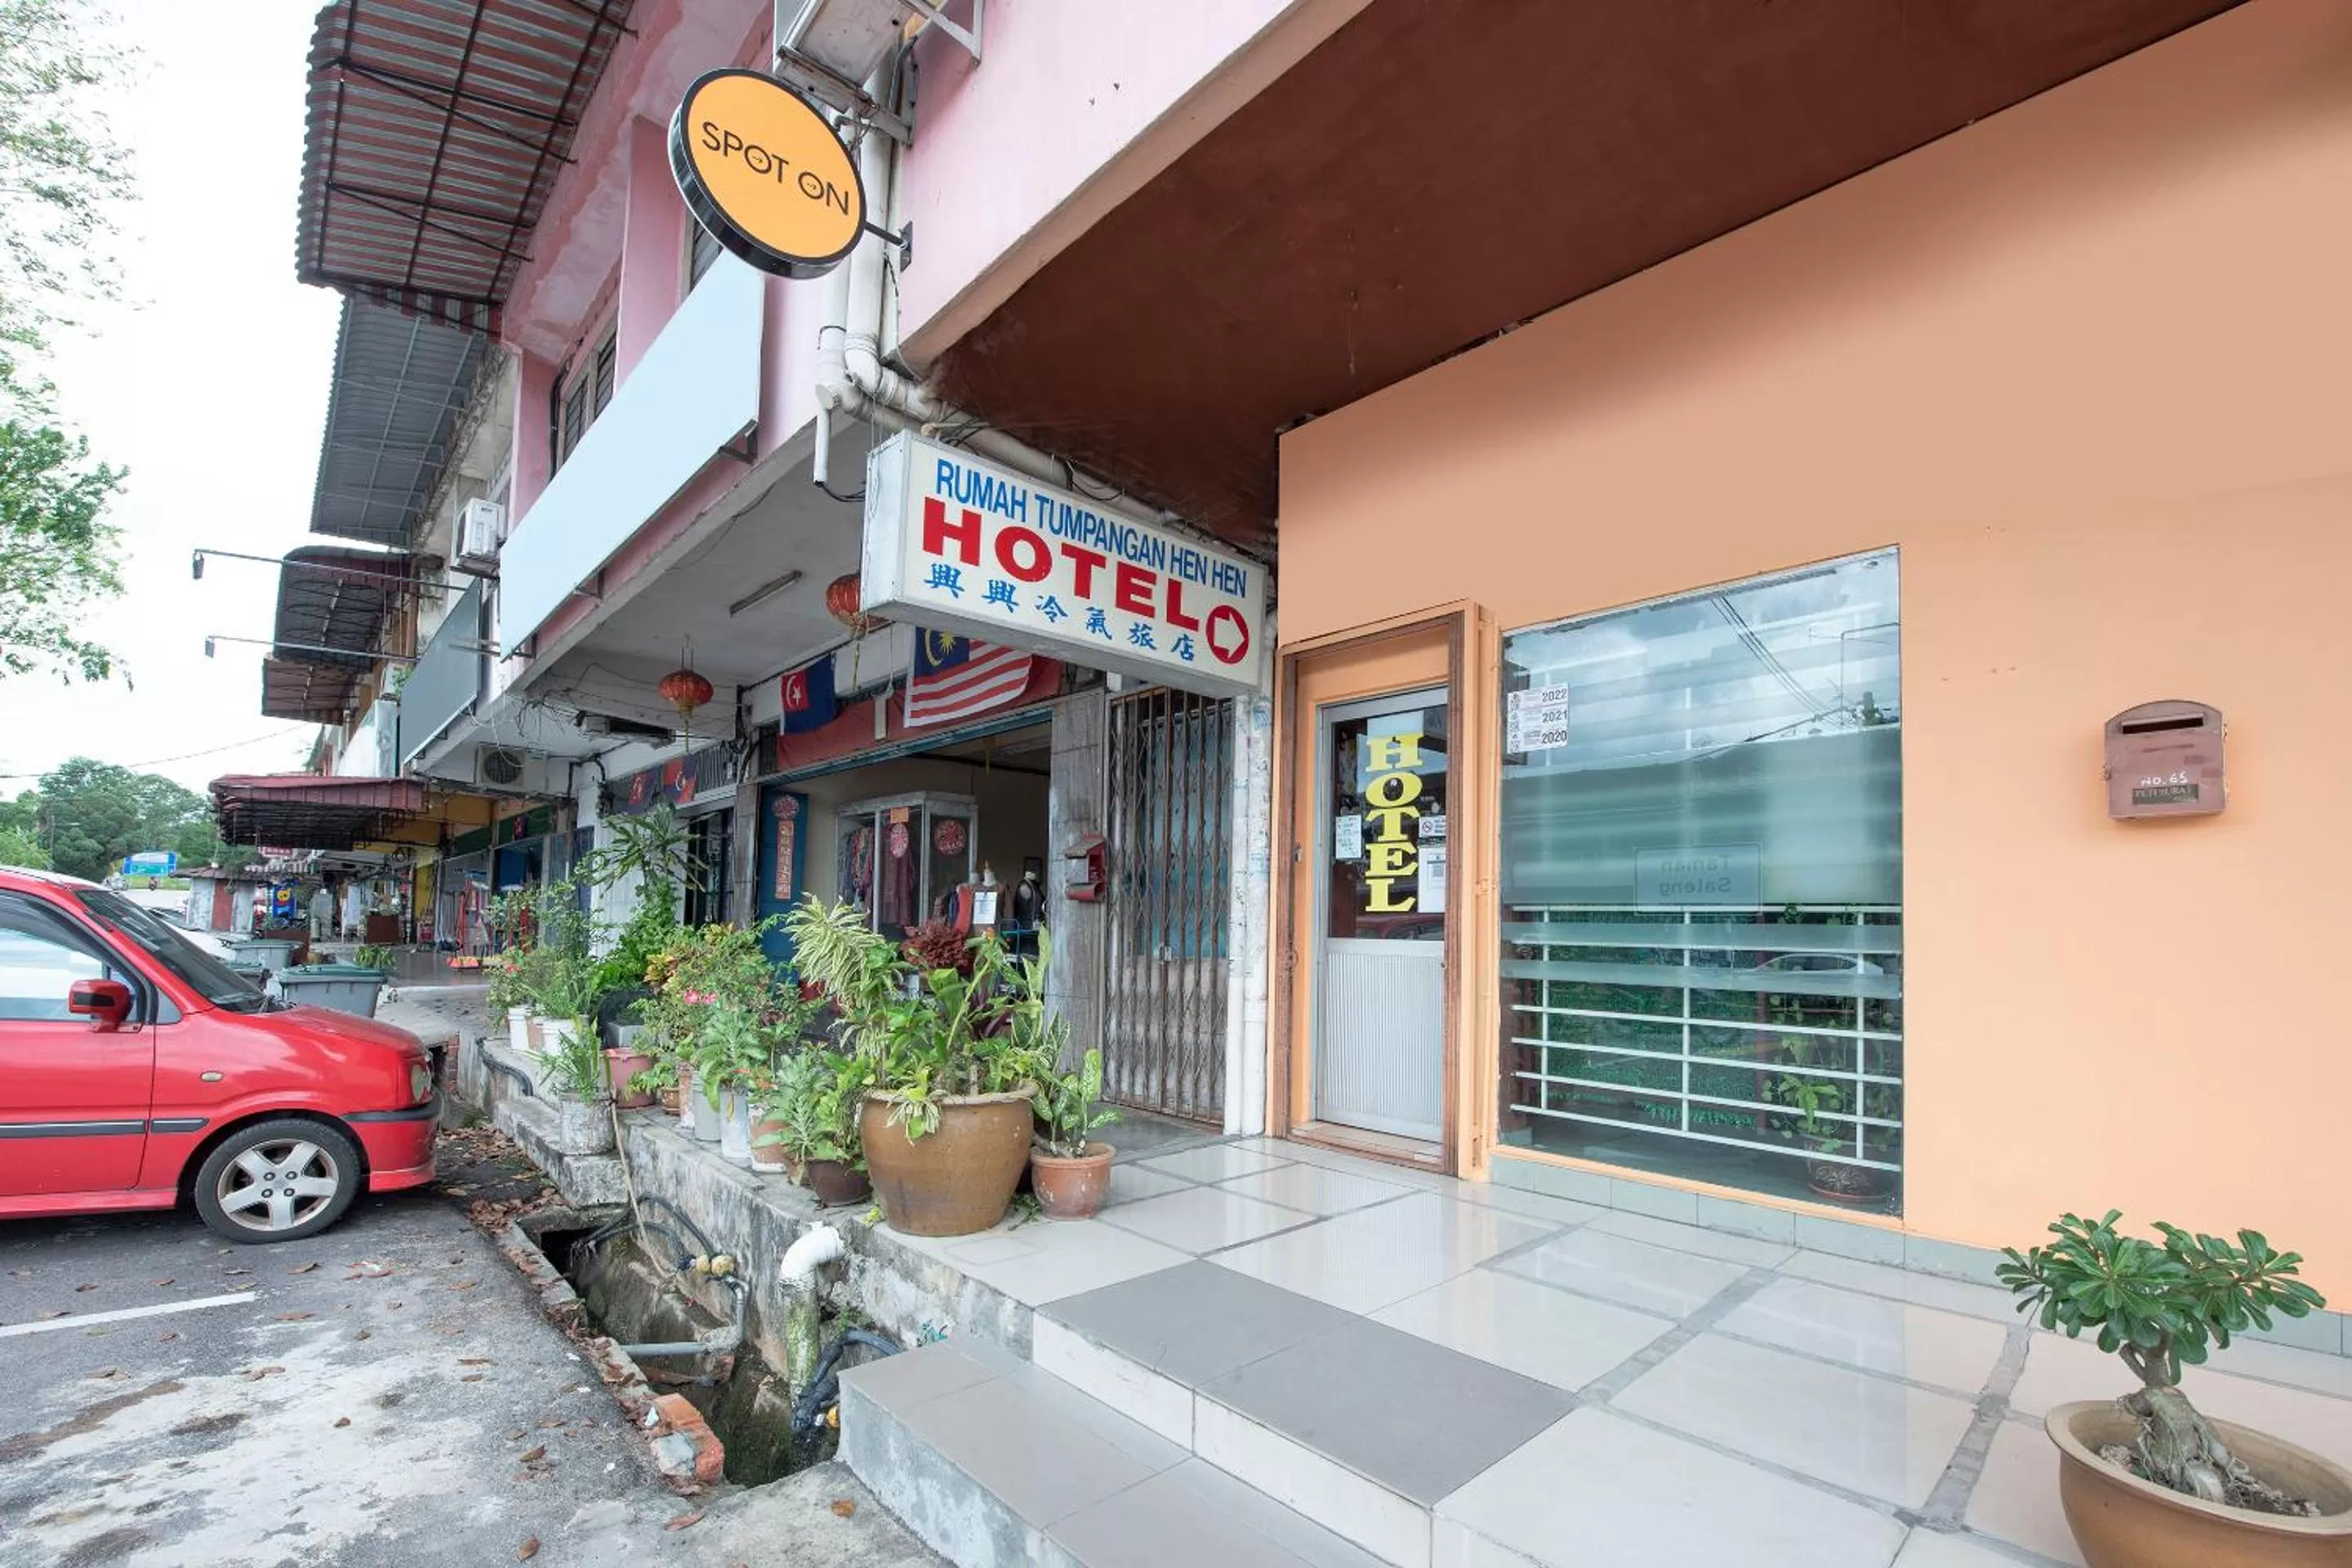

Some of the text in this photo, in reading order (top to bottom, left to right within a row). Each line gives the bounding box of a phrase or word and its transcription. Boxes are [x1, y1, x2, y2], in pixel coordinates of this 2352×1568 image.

[702, 122, 849, 216] SPOT ON
[923, 497, 1199, 632] HOTEL
[936, 458, 1246, 598] RUMAH TUMPANGAN HEN HEN
[1541, 730, 1567, 744] 2020
[1542, 688, 1567, 702] 2022
[1542, 710, 1567, 723] 2021
[1365, 733, 1423, 912] HOTEL
